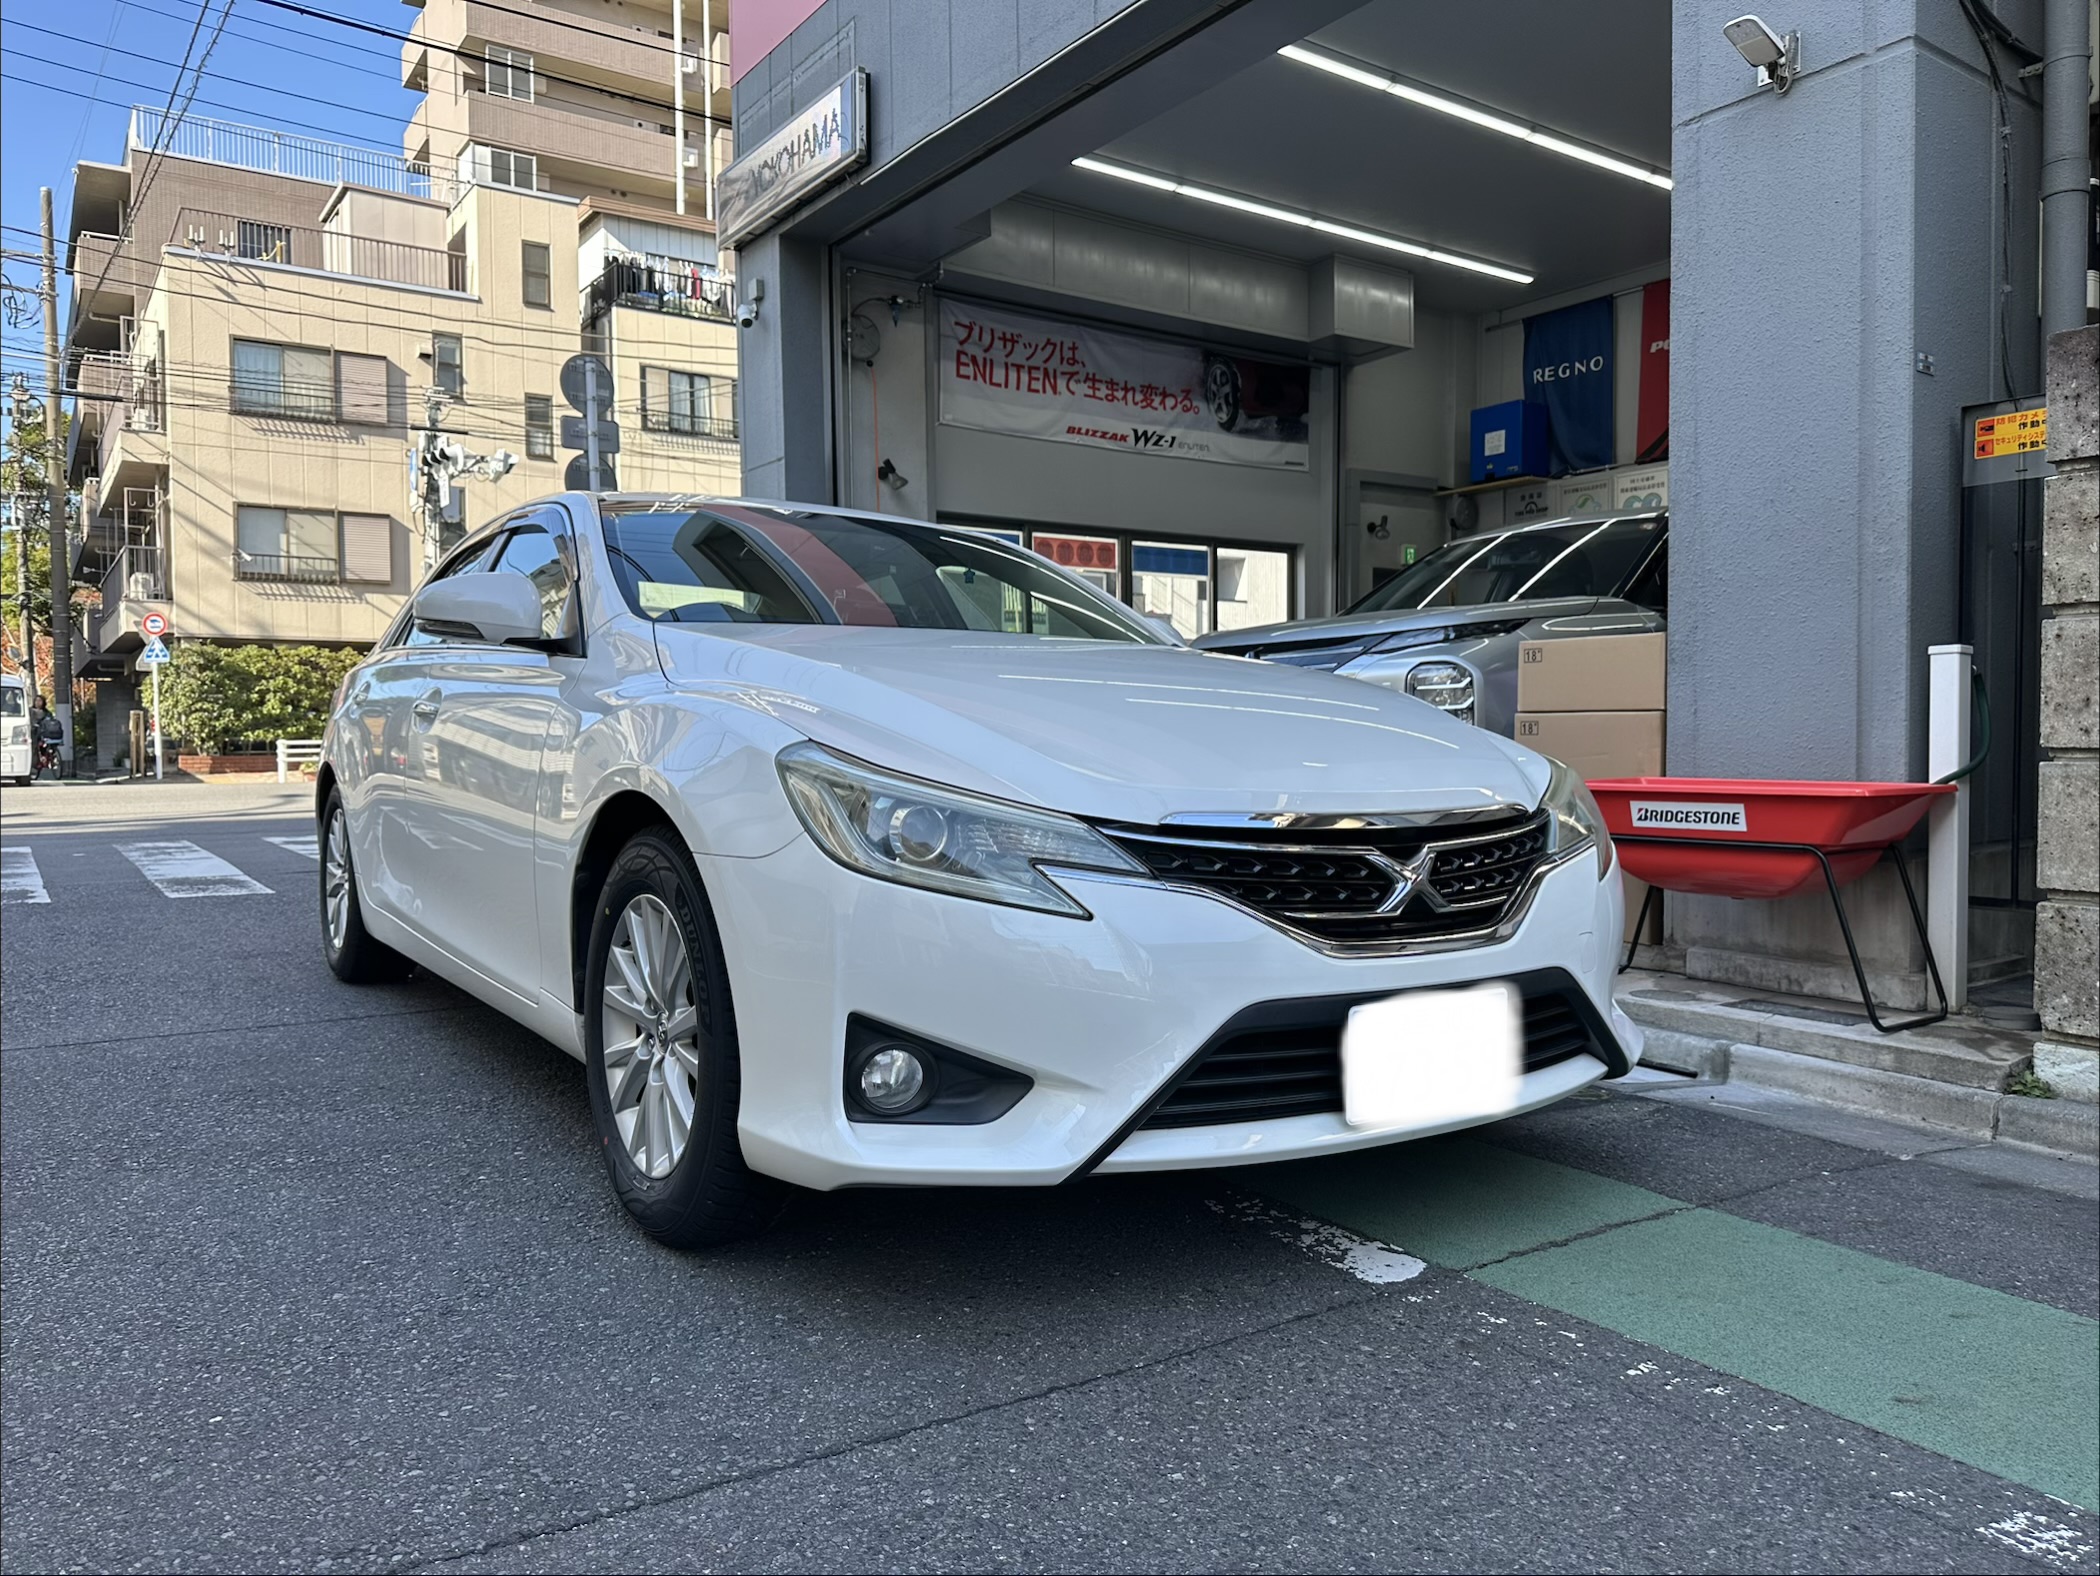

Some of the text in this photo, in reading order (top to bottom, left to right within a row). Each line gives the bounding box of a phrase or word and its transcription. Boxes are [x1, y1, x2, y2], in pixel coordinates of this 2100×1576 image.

[749, 108, 841, 197] YOKOHAMA
[954, 320, 1087, 368] ブリザックは、
[1532, 355, 1604, 384] REGNO
[1066, 425, 1130, 443] BLIZZAK
[1131, 428, 1177, 449] WZ-1
[1995, 431, 2045, 446] セキュリティシステ
[1637, 807, 1741, 825] BRIDGESTONE
[680, 906, 711, 1026] DUNLOP
